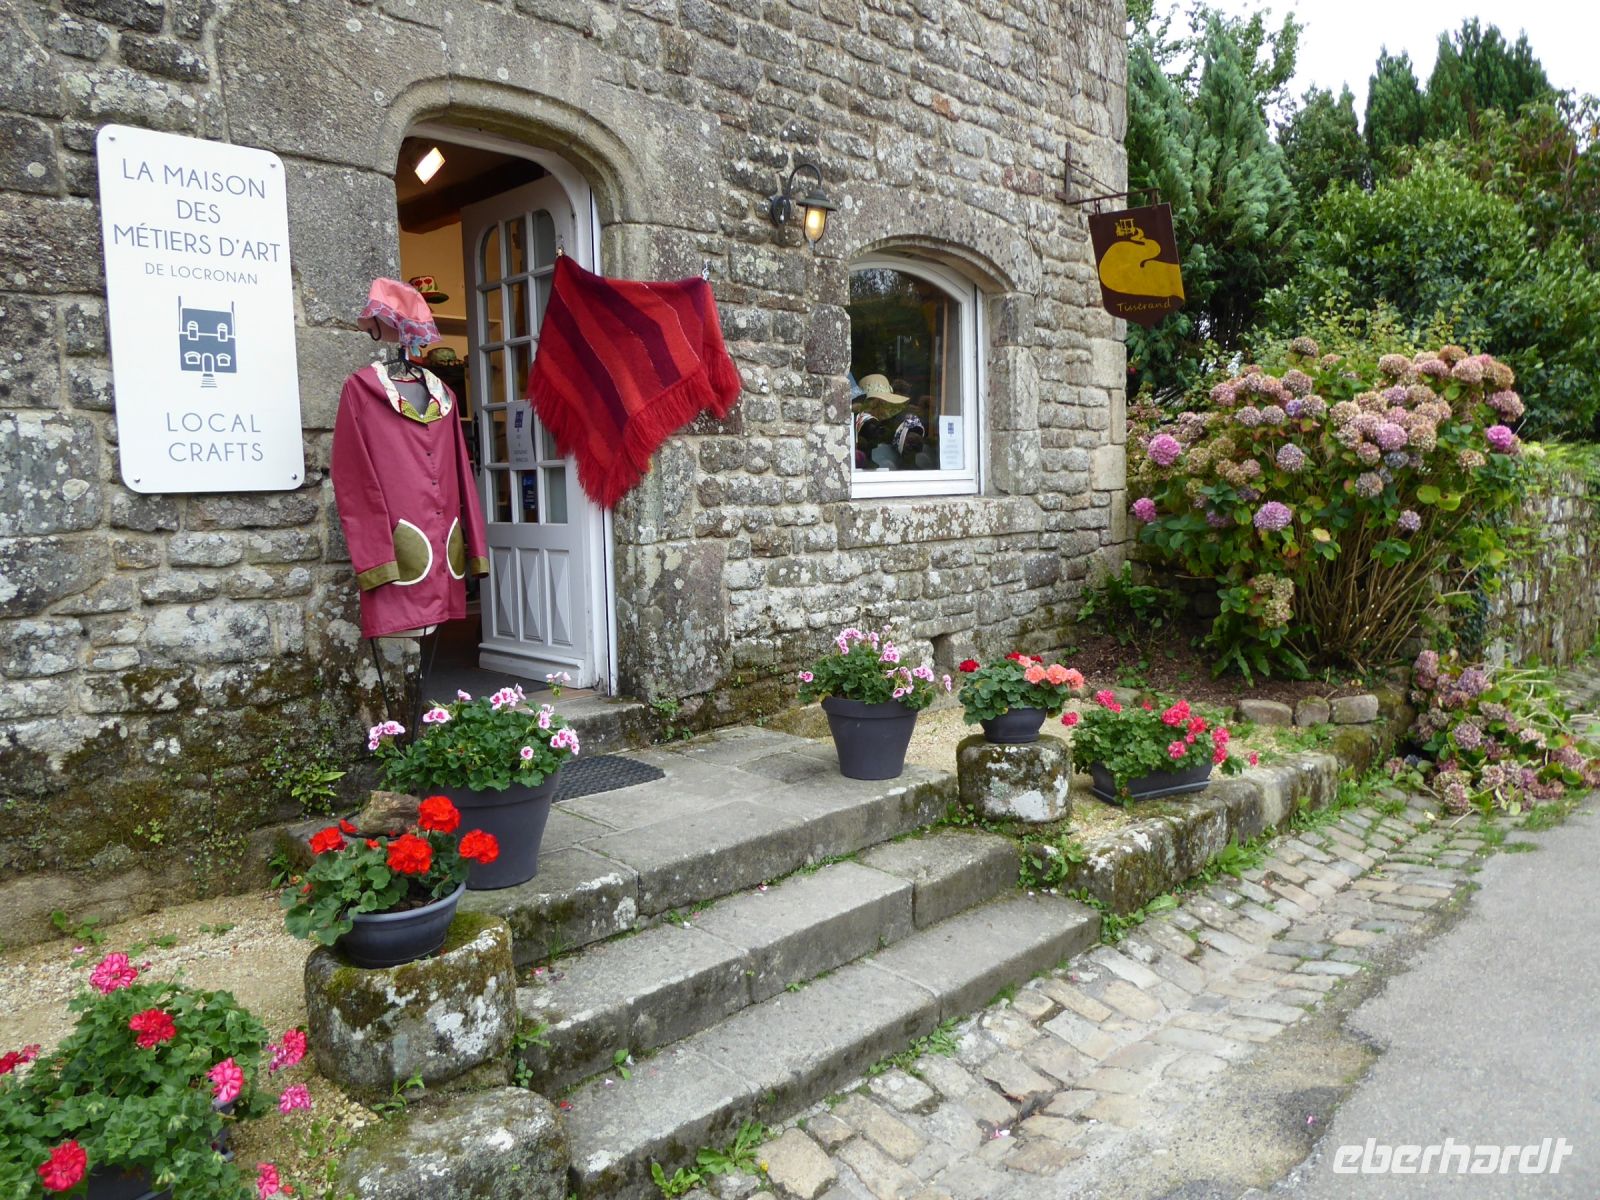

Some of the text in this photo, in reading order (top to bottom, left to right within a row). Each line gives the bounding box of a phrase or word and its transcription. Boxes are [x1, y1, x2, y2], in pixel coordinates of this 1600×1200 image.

[122, 158, 265, 199] LA MAISON
[176, 199, 221, 224] DES
[113, 222, 281, 262] MÉTIERS D'ART
[145, 262, 258, 285] DE LOCRONAN
[166, 412, 262, 433] LOCAL
[168, 442, 264, 462] CRAFTS
